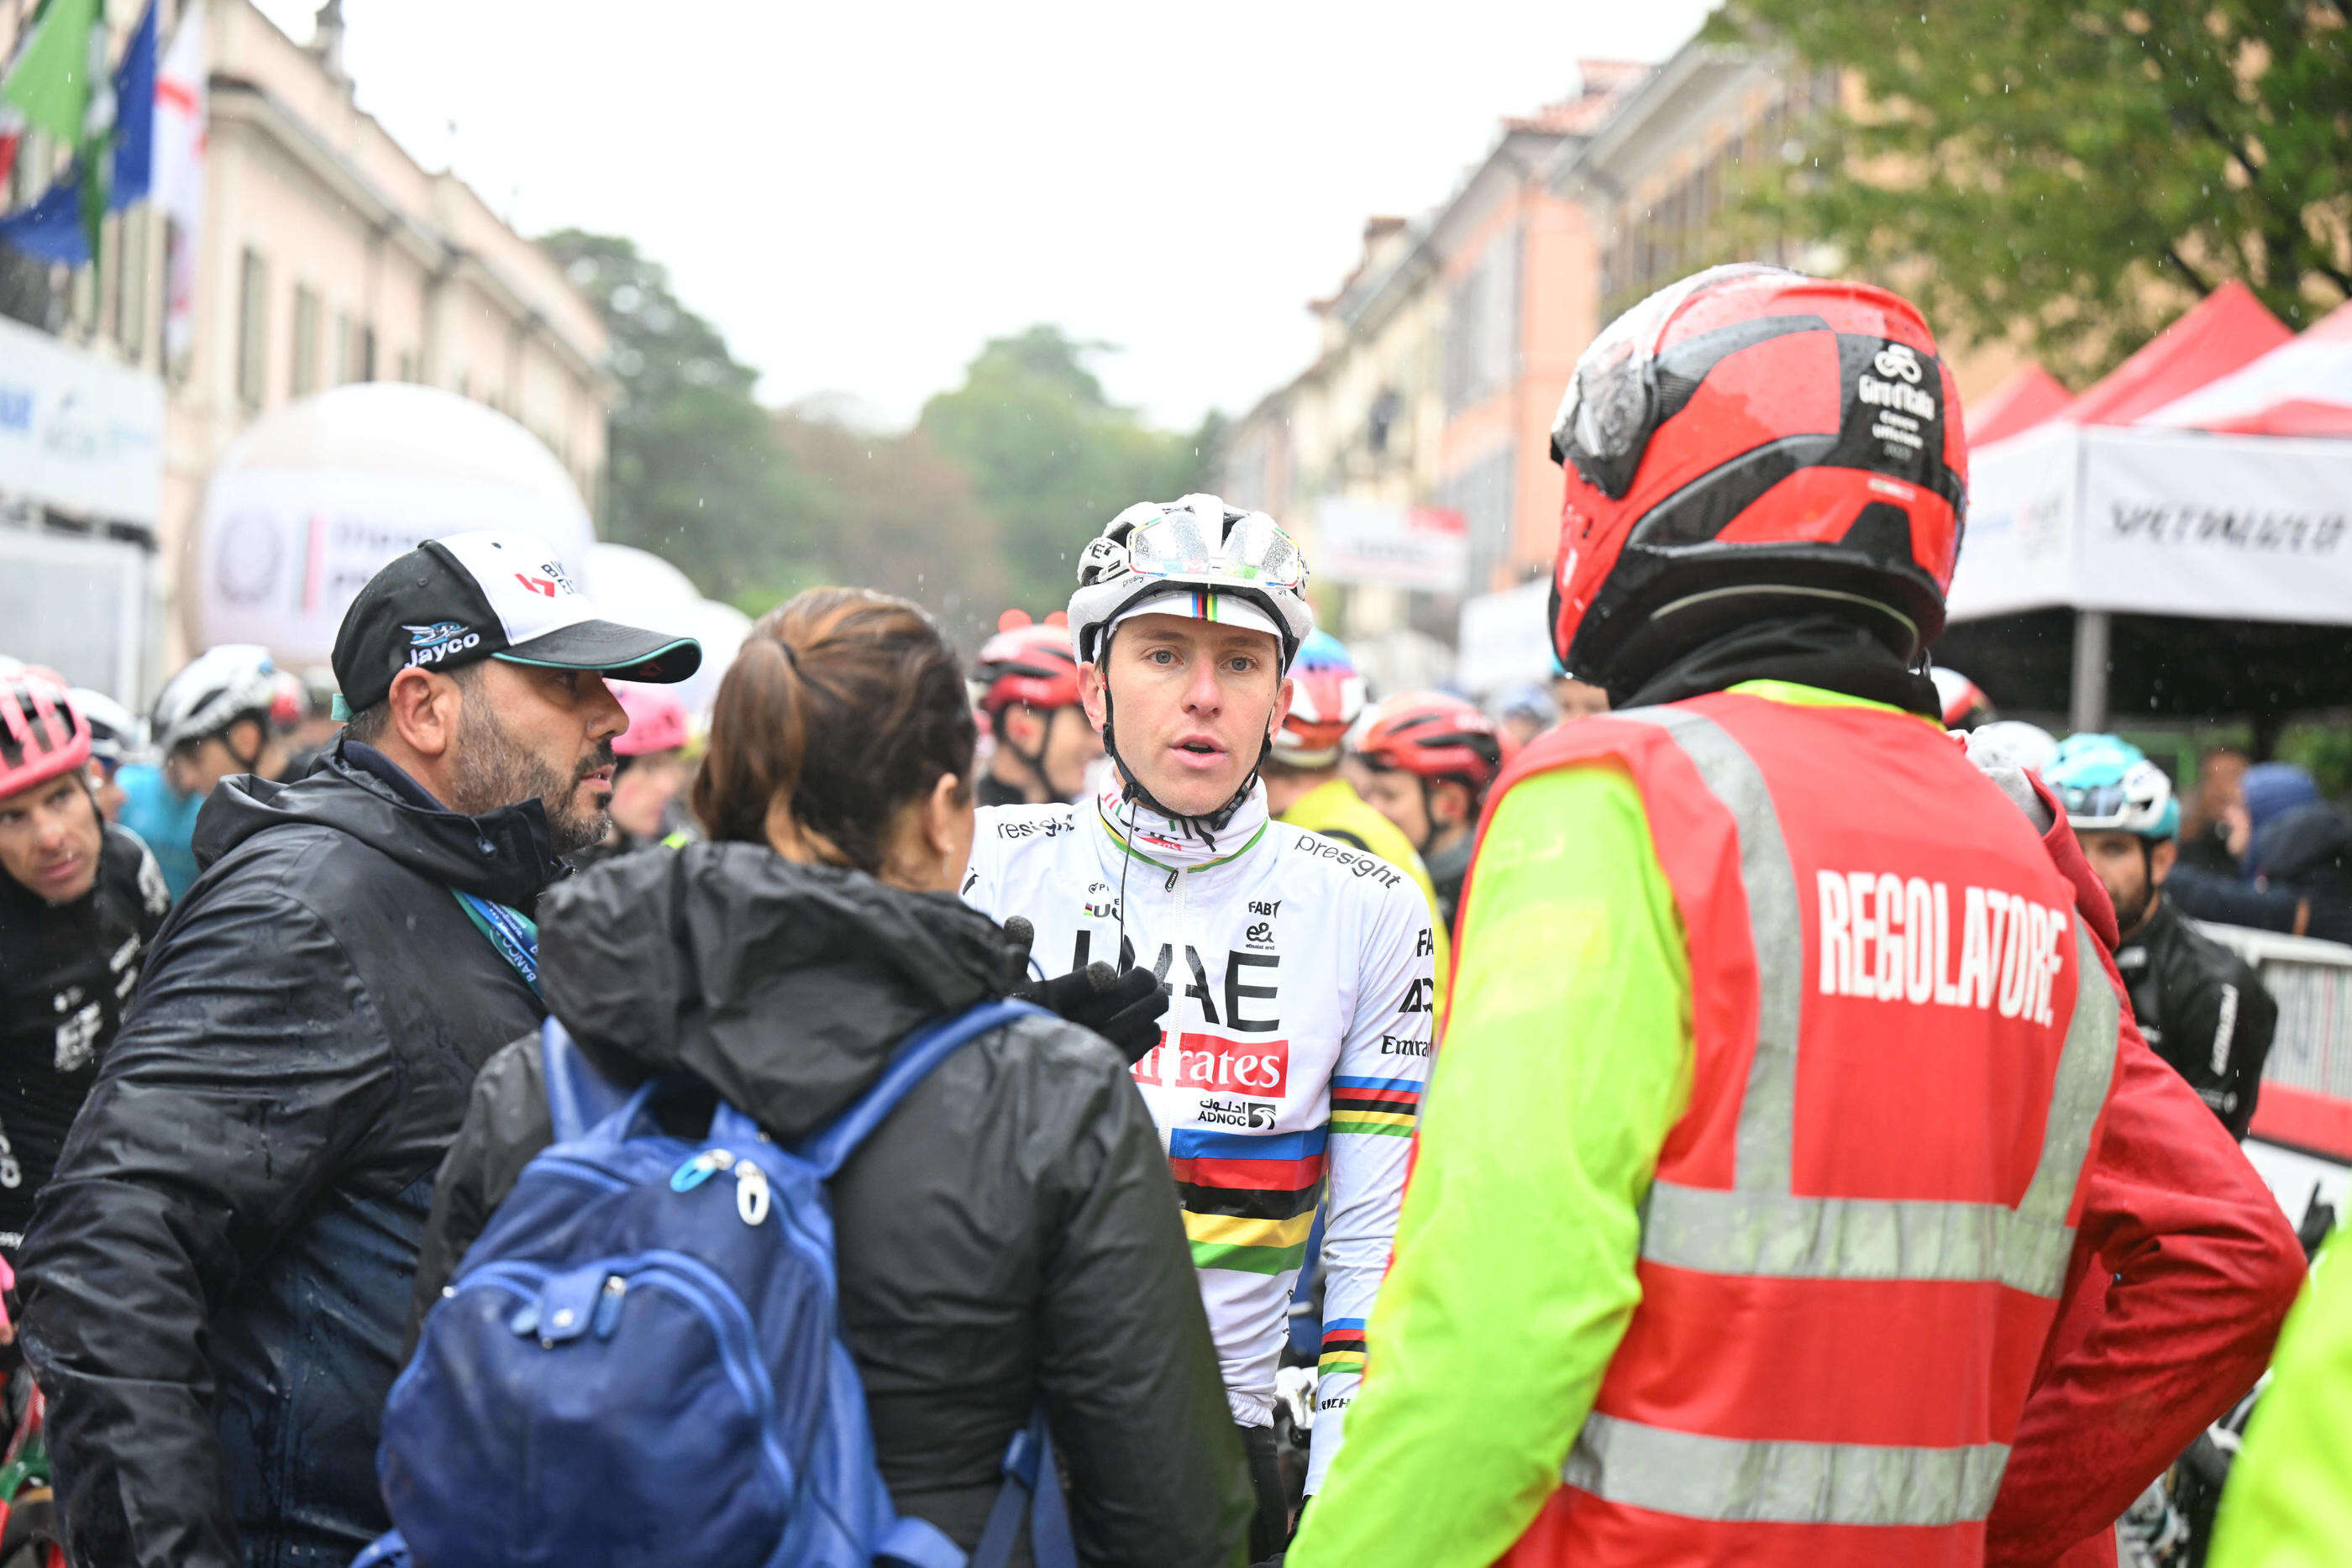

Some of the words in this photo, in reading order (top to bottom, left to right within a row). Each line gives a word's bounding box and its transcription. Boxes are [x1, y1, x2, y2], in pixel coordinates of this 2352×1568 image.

[403, 632, 480, 669] Jayco
[1294, 835, 1401, 889] presight
[1817, 869, 2067, 1030] REGOLATORE
[1198, 1111, 1247, 1126] ADNOC
